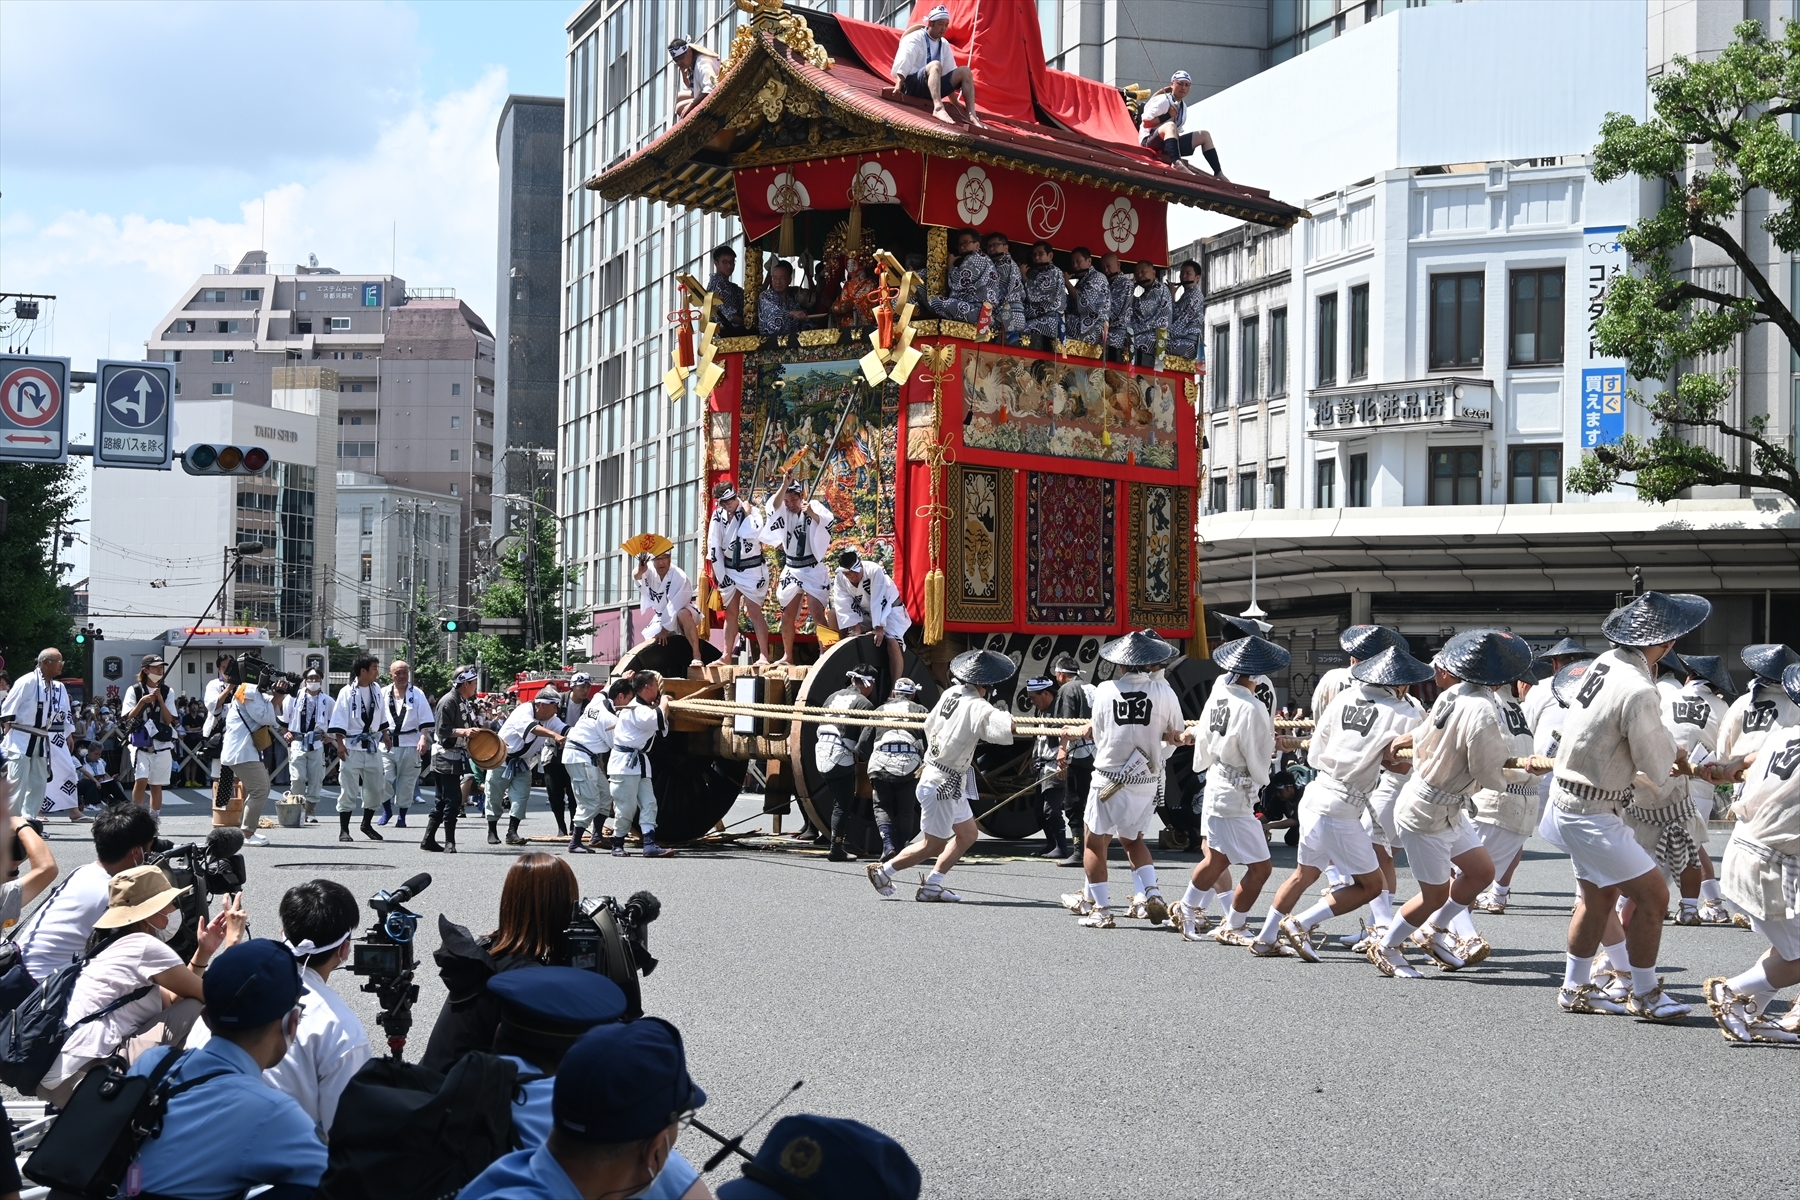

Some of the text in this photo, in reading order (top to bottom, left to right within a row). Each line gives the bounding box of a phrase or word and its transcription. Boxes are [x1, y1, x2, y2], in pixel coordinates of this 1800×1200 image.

[1605, 376, 1619, 412] すぐ
[1314, 390, 1444, 425] 池善化粧品店
[1586, 375, 1602, 446] 買えます
[103, 436, 164, 453] 路線バスを除く
[277, 429, 299, 443] SEED
[106, 685, 120, 698] 救
